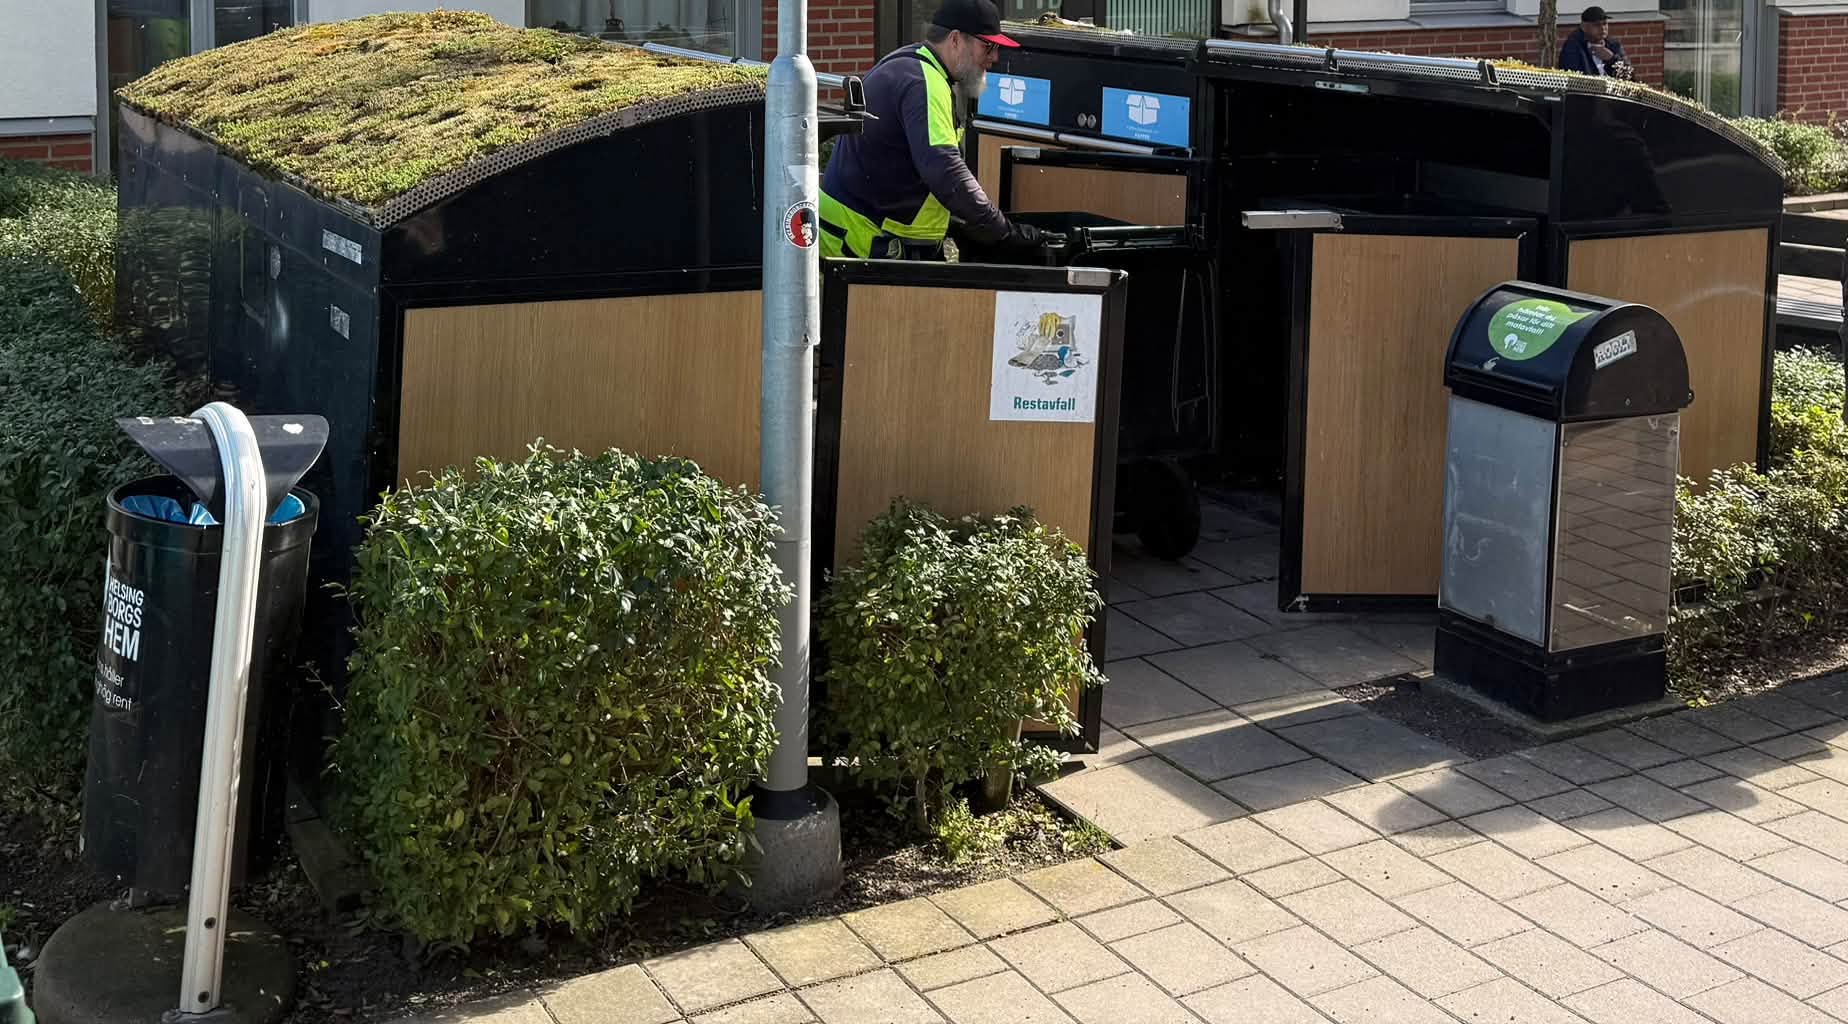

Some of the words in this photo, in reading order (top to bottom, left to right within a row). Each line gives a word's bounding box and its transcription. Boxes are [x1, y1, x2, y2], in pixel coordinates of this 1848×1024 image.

[1013, 396, 1076, 411] Restavfall
[109, 576, 144, 606] HELSING
[107, 592, 142, 628] BORGS
[104, 614, 140, 661] HEM
[112, 693, 132, 712] rent
